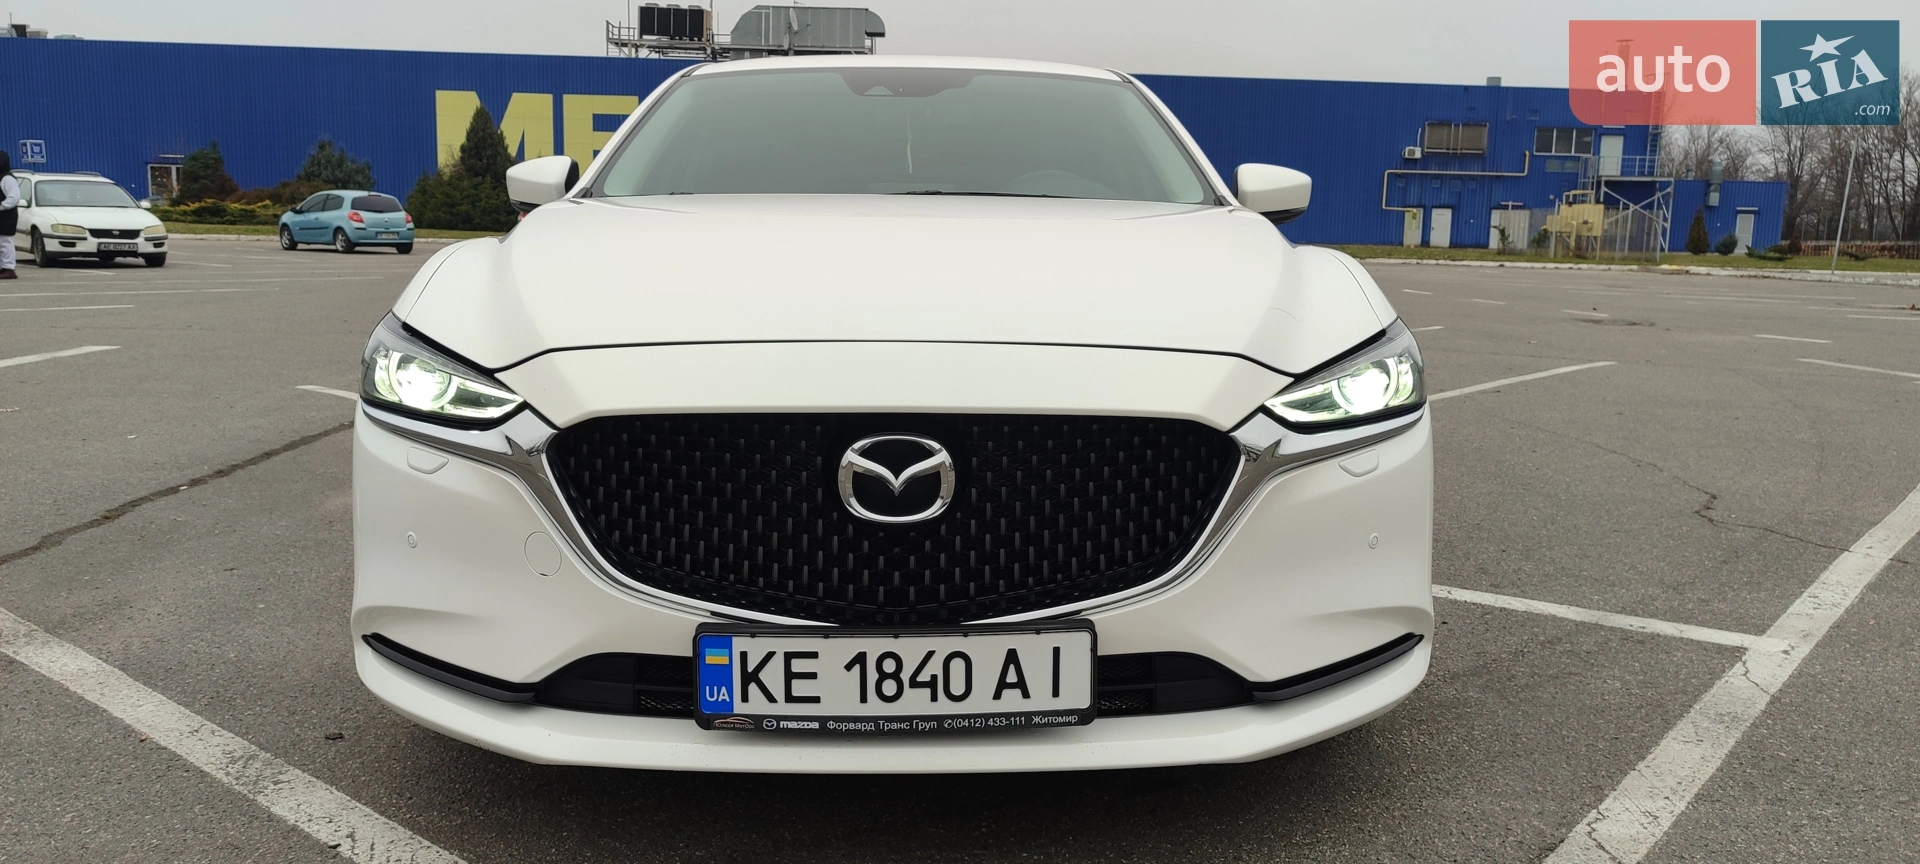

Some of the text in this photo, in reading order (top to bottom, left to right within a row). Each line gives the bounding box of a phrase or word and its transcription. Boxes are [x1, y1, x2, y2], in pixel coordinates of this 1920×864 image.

[738, 650, 821, 703] KE
[843, 650, 973, 703] 1840
[705, 686, 730, 702] UA
[779, 720, 820, 729] mazda
[827, 715, 1078, 731] Форвард Транс Груп (0412) 433-111 Житомир
